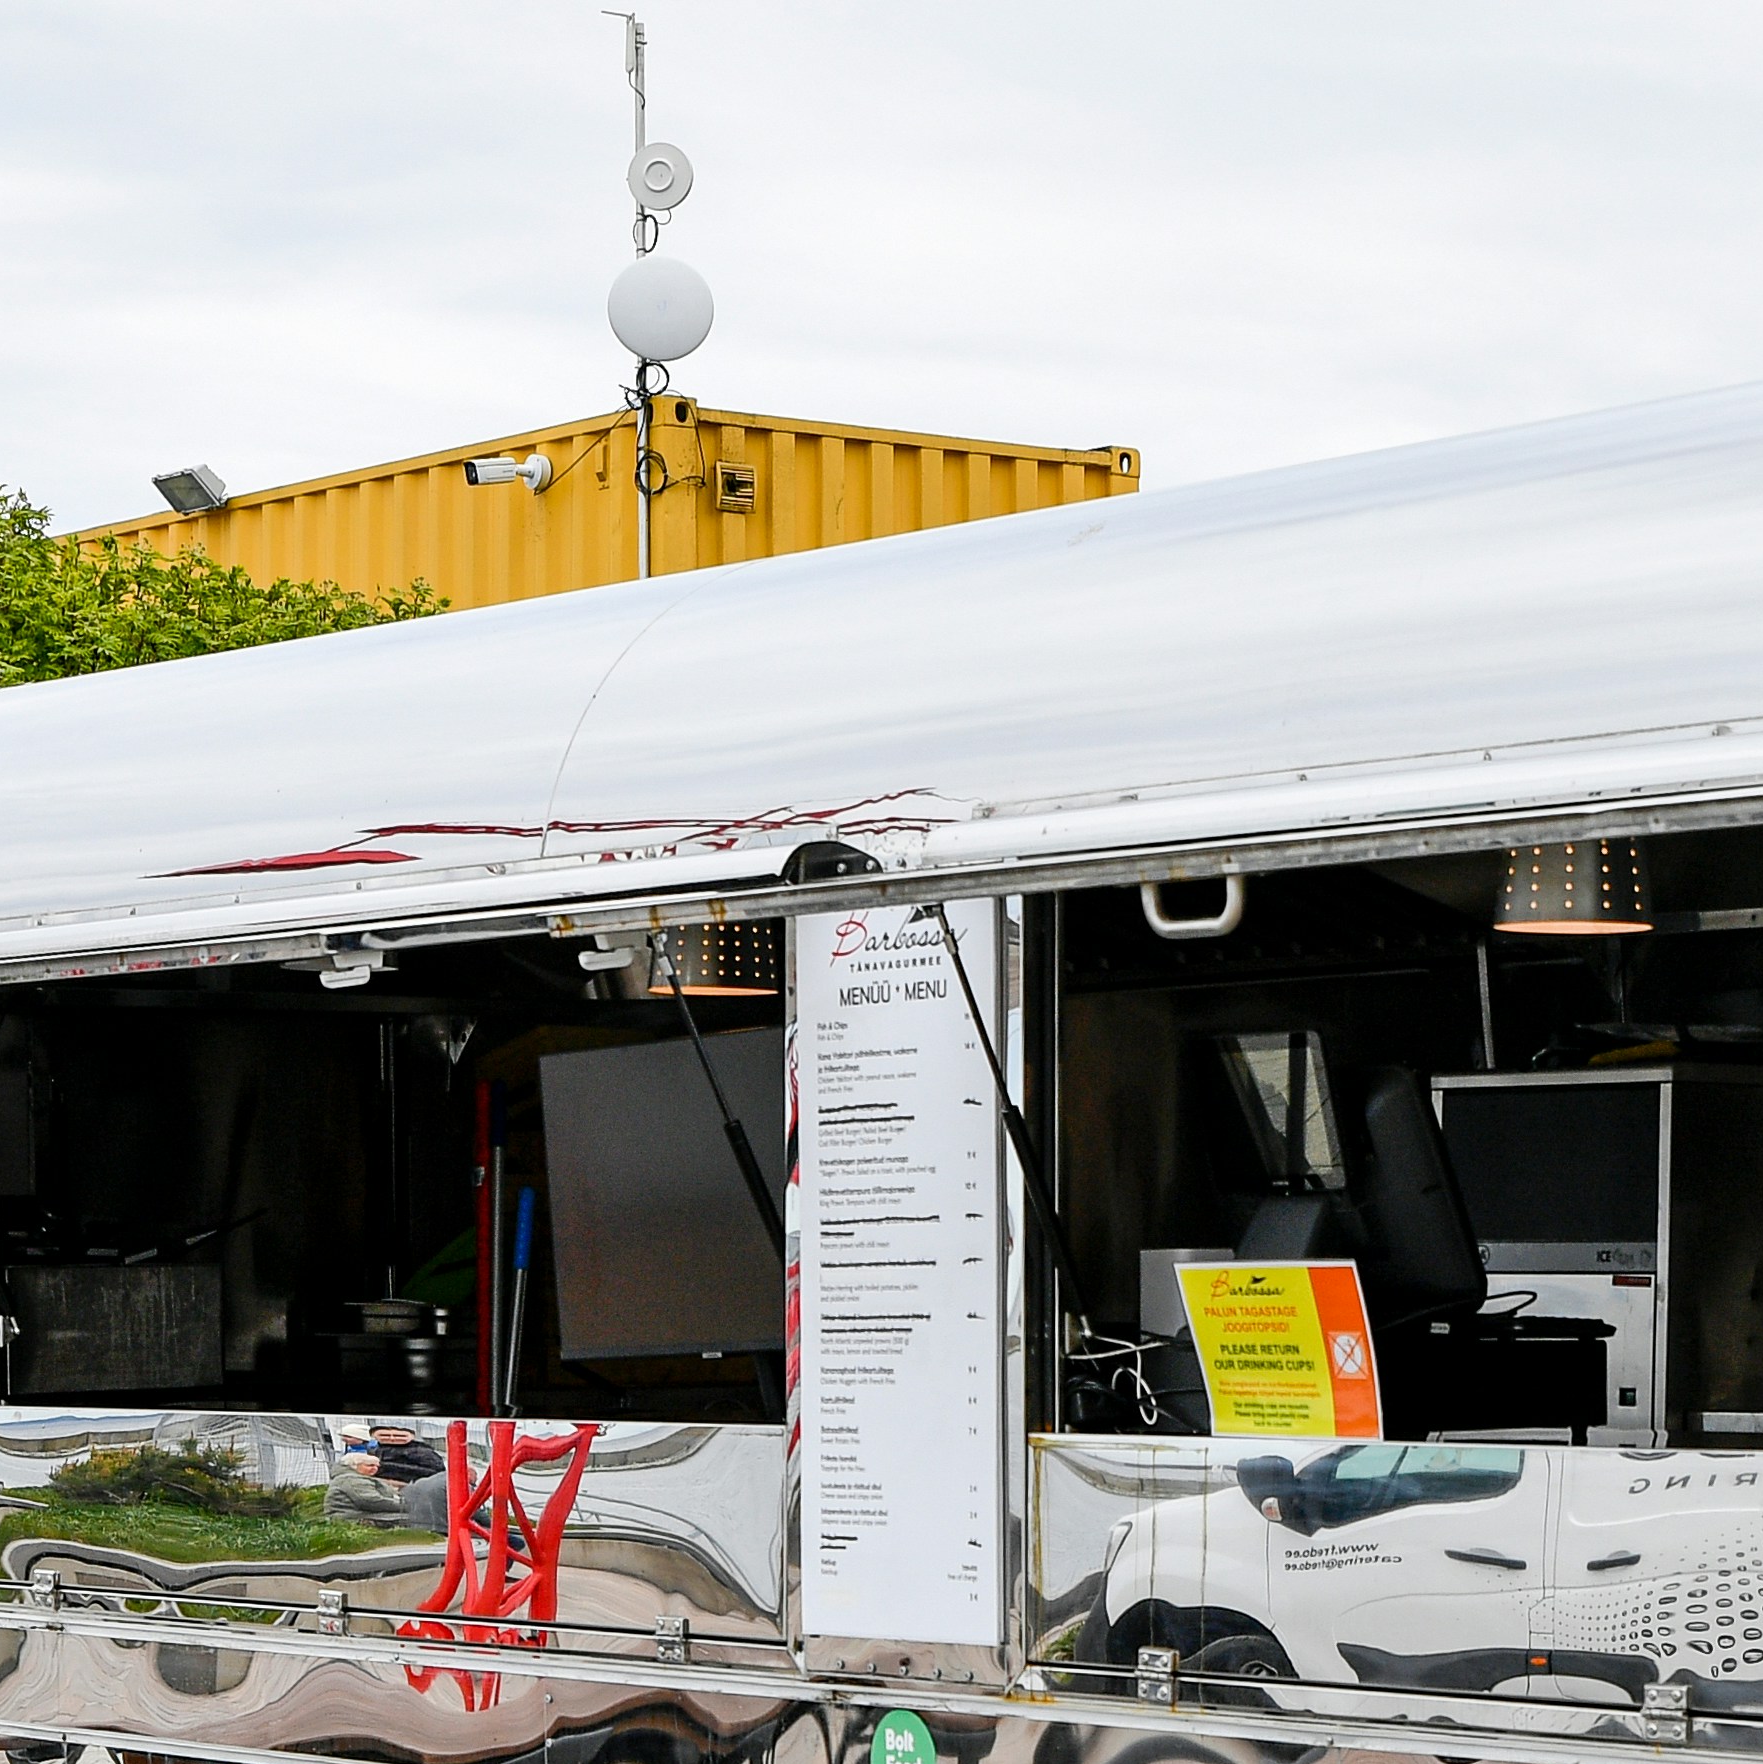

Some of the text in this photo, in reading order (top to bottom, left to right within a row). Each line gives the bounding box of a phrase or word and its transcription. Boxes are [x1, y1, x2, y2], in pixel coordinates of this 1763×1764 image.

[839, 979, 947, 1007] MENÜÜ MENU
[1204, 1306, 1298, 1317] PALUN TAGASTAGE
[1220, 1344, 1299, 1355] PLEASE RETURN
[1214, 1360, 1235, 1370] OUR
[1237, 1360, 1283, 1371] DRINKING
[885, 1728, 914, 1752] Bolt
